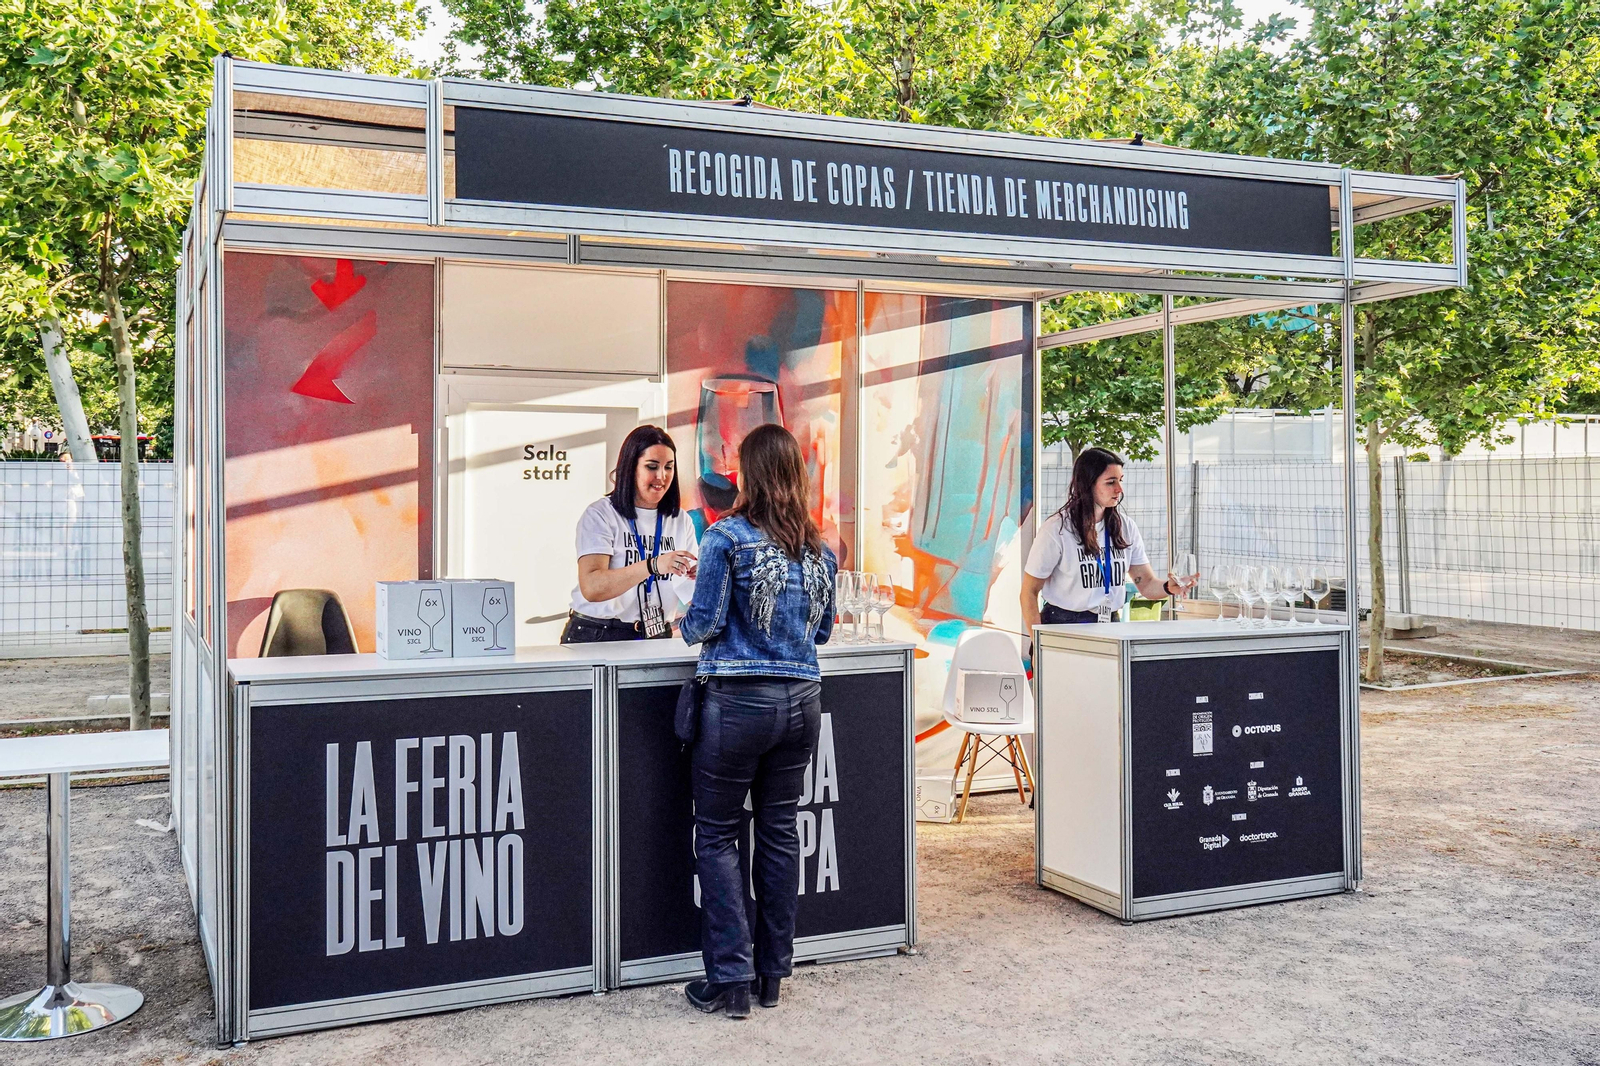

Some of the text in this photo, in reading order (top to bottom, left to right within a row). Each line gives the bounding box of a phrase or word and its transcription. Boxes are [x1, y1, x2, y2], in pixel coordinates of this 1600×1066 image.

[668, 148, 783, 201] RECOGIDA
[791, 159, 818, 203] DE
[826, 162, 896, 209] COPAS
[922, 170, 998, 217] TIENDA
[1003, 177, 1029, 219] DE
[1034, 179, 1189, 230] MERCHANDISING
[523, 444, 567, 461] Sala
[523, 463, 571, 480] staff
[397, 628, 422, 637] VINO
[462, 626, 486, 635] VINO
[1244, 723, 1282, 735] OCTOPUS
[326, 731, 526, 847] LA FERIA
[1198, 834, 1222, 844] Granada
[1203, 841, 1222, 851] Digital
[326, 833, 525, 957] DEL VINO
